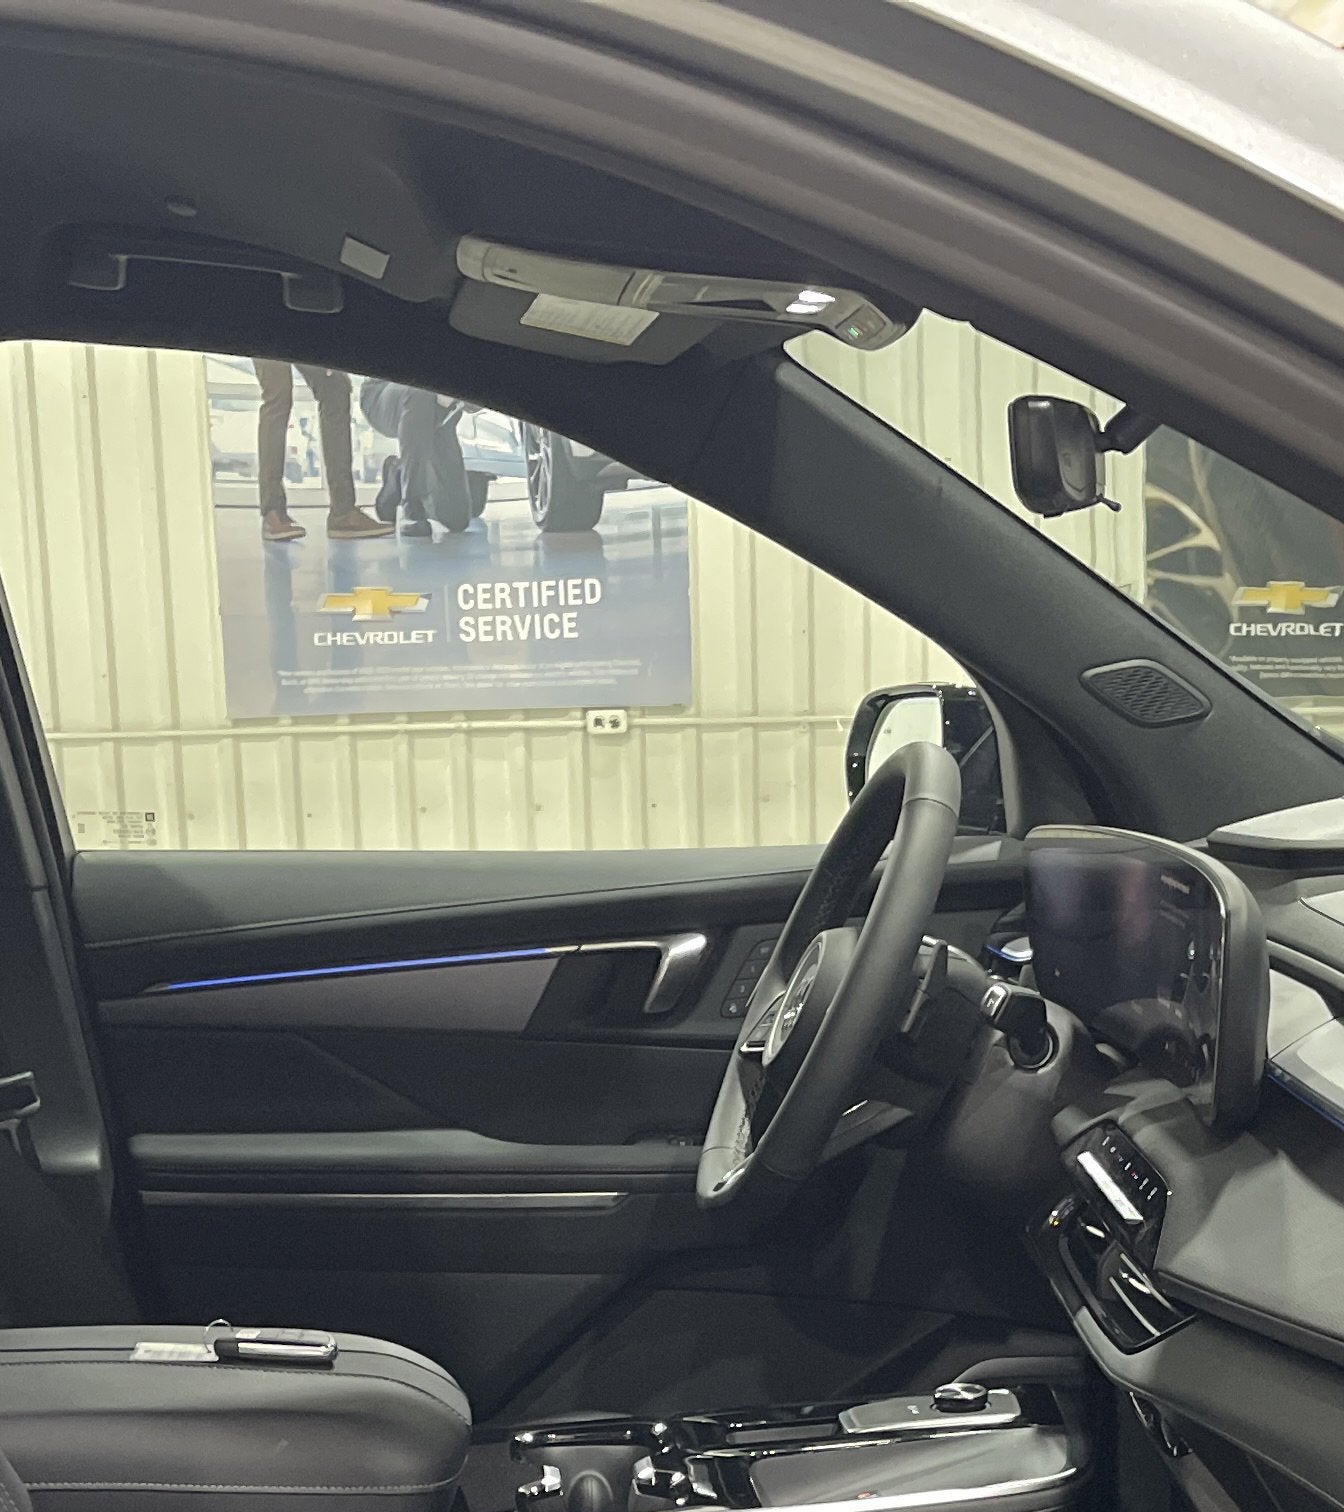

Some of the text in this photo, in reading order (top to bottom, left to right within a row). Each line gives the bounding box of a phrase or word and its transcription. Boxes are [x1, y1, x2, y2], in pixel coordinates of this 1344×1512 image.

[457, 578, 602, 611] CERTIFIED
[313, 630, 437, 646] CHEVROLET
[459, 612, 579, 642] SERVICE
[1229, 622, 1344, 637] CHEVROLET
